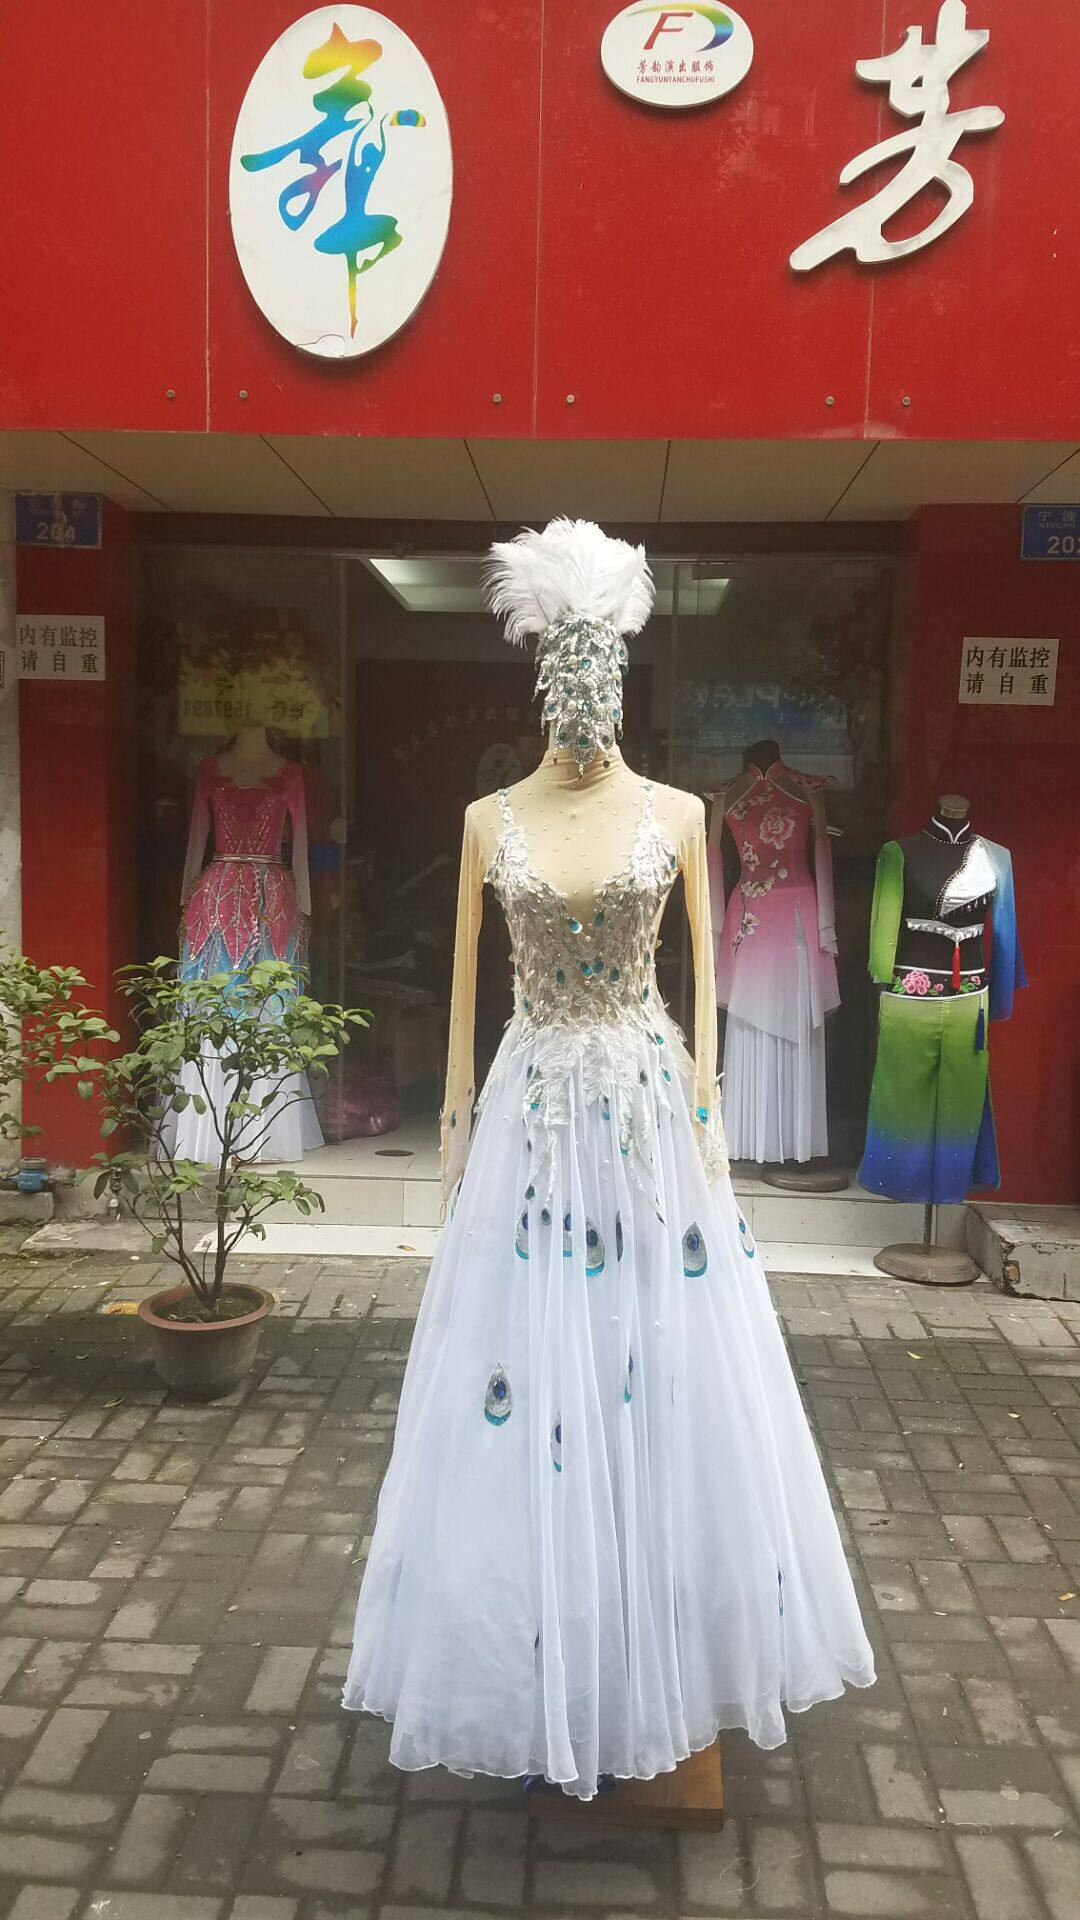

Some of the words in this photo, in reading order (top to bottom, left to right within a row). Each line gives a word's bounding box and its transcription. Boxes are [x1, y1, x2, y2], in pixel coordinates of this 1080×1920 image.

[636, 60, 715, 74] 芳韵演出服饰
[636, 75, 715, 83] FANGYUNYANCHUFUSHI
[789, 0, 1006, 271] 芳
[20, 624, 98, 648] 内有监控
[20, 649, 98, 673] 请自重
[966, 646, 1050, 668] 内有监控
[965, 671, 1048, 694] 请自重
